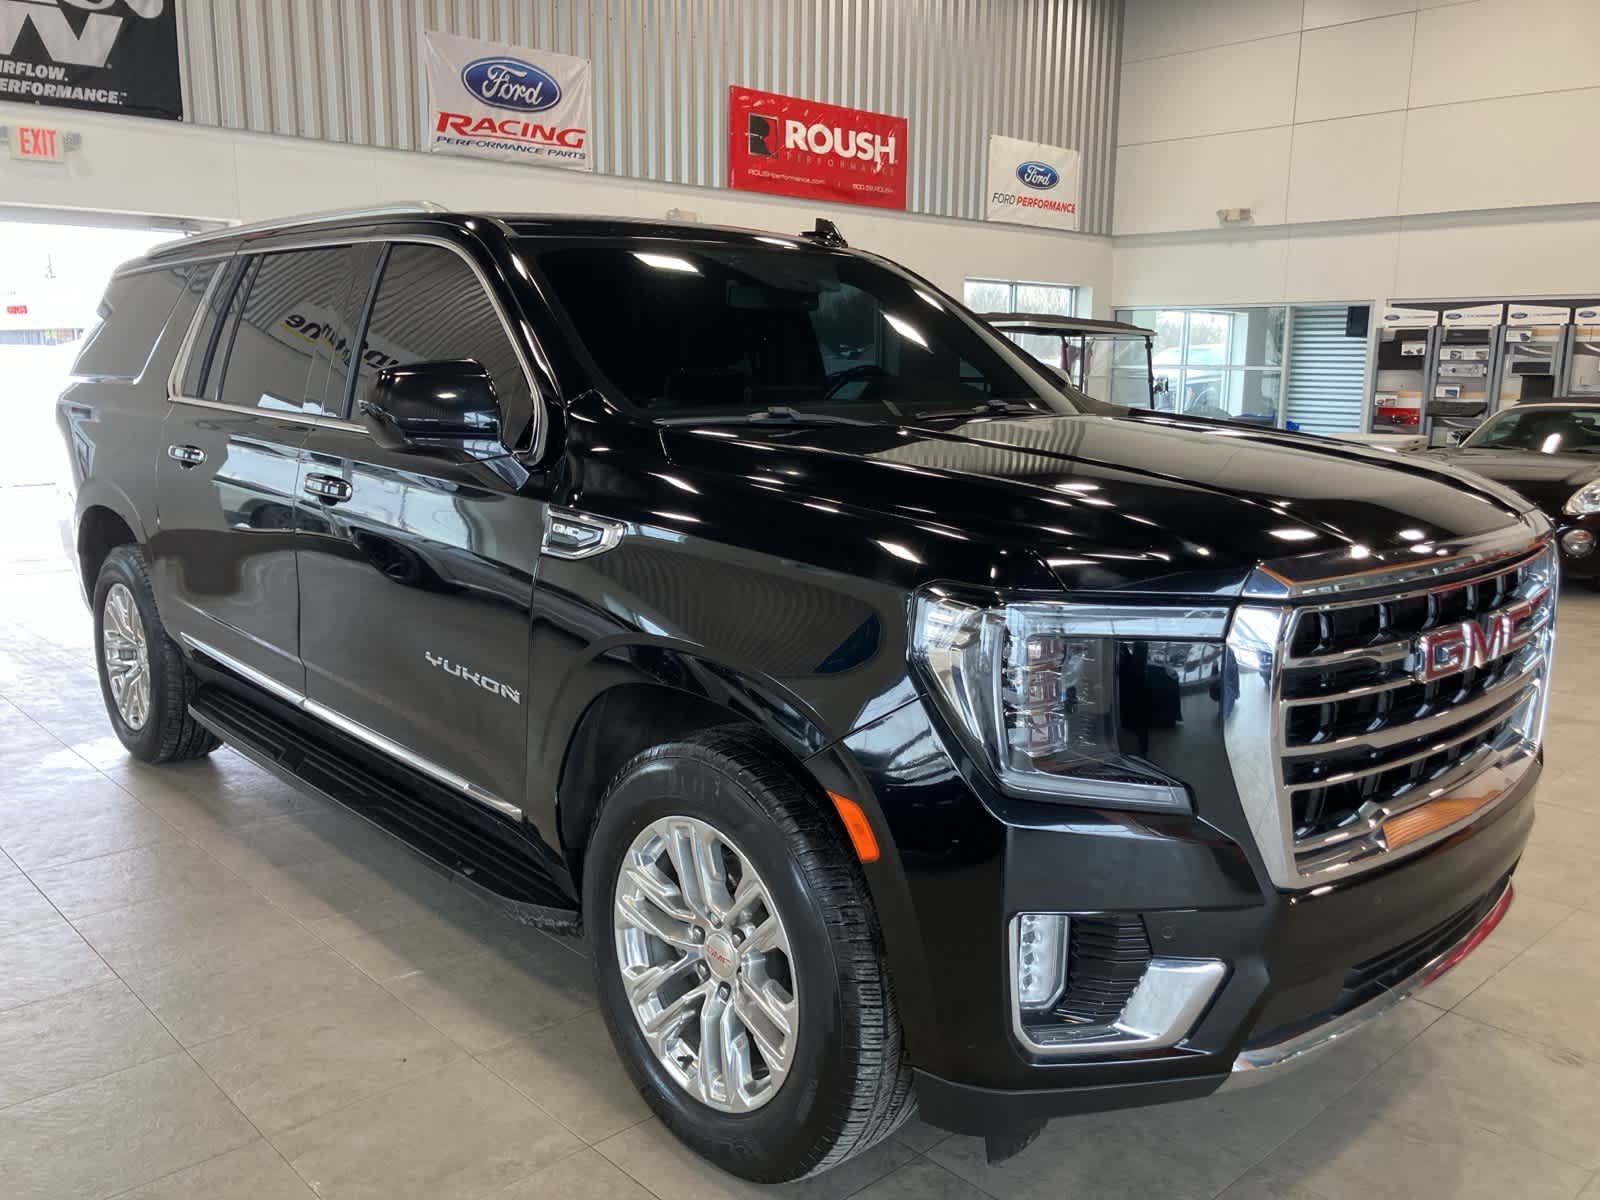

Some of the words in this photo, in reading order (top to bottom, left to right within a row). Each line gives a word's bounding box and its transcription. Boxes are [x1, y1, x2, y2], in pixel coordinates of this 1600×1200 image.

[482, 64, 543, 105] Ford
[18, 127, 57, 157] EXIT
[436, 111, 586, 149] RACING
[785, 119, 896, 164] ROUSH
[436, 135, 545, 155] PERFORMANCE
[547, 149, 586, 160] PARTS
[786, 151, 895, 176] PERFORMANCE
[1024, 164, 1052, 186] Ford
[992, 192, 1015, 206] FORD
[1016, 195, 1076, 214] PERFORMANCE
[552, 522, 579, 538] GMC
[1418, 604, 1532, 684] GMC
[424, 650, 521, 705] YUKON
